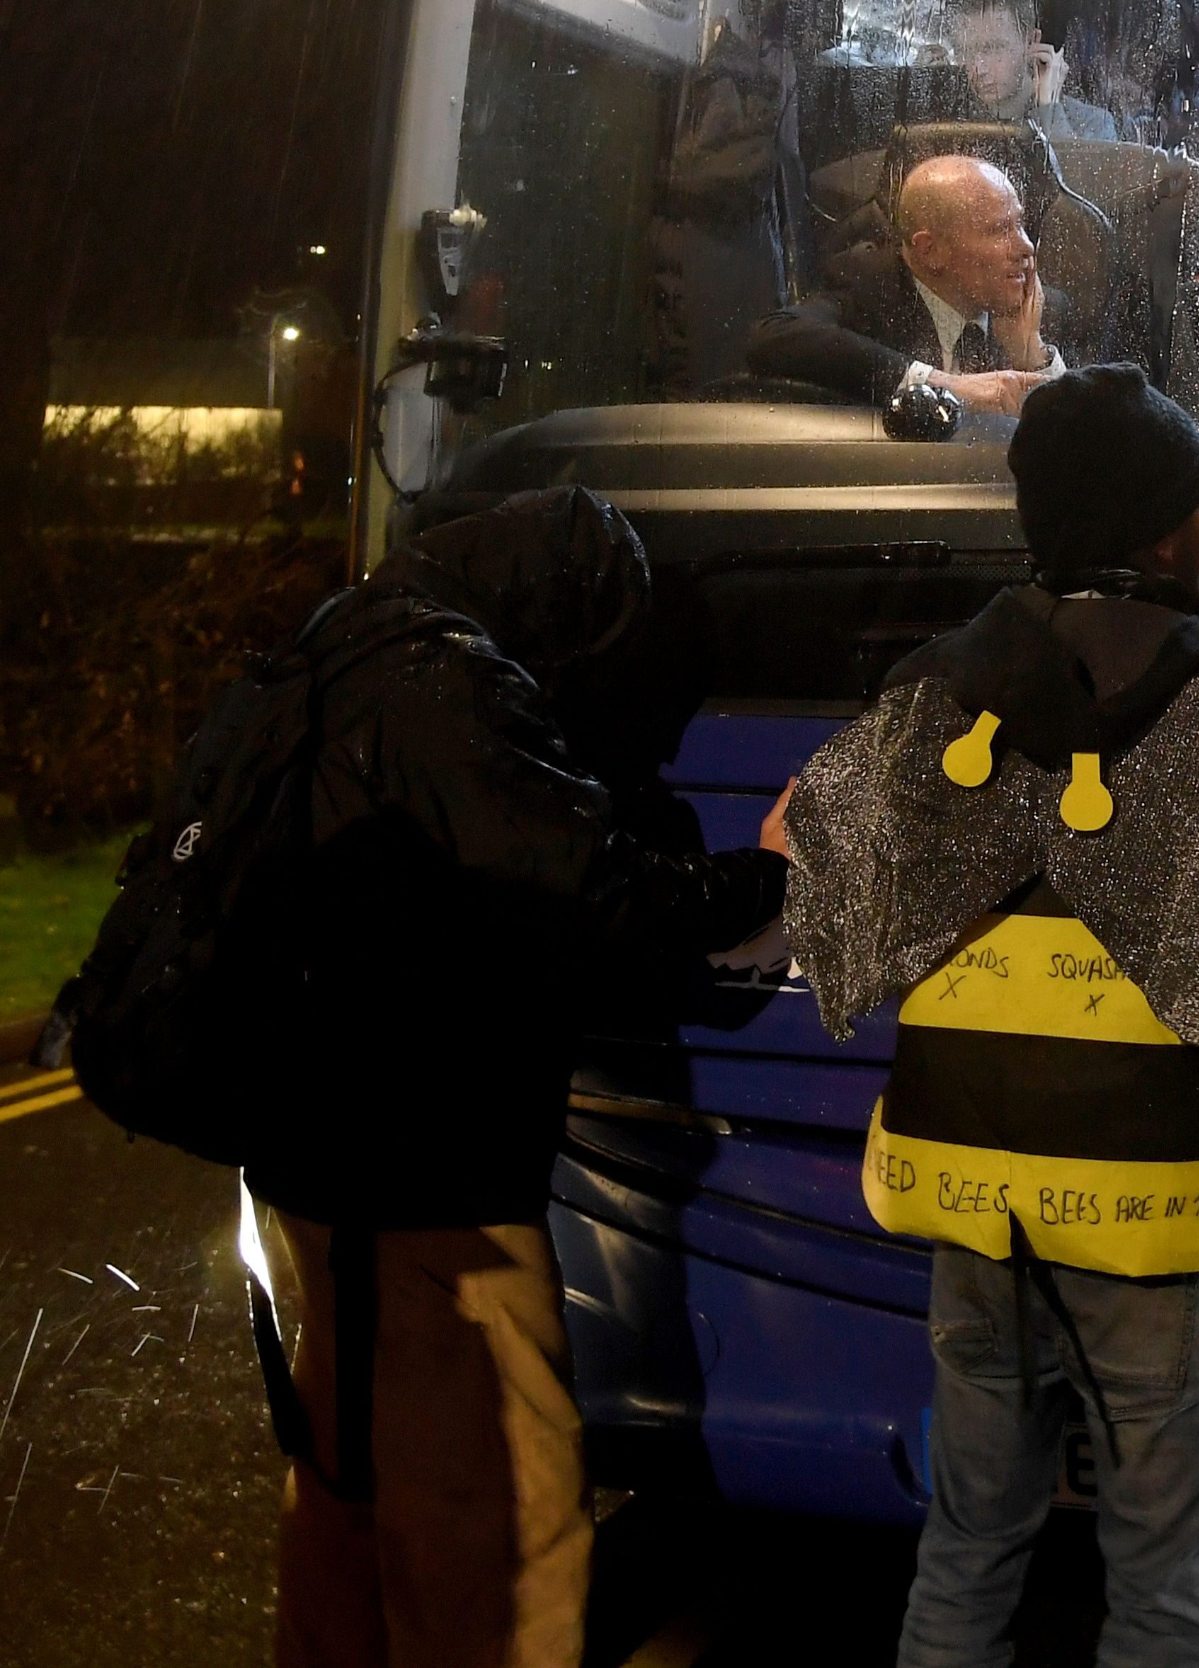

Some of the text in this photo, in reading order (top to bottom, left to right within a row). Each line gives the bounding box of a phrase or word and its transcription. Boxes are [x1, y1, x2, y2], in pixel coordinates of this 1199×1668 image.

[950, 947, 1009, 977] ONDS
[938, 1171, 1010, 1213] BEES
[1039, 1187, 1102, 1225] BEES
[1115, 1194, 1155, 1222] ARE
[1164, 1195, 1187, 1217] IN
